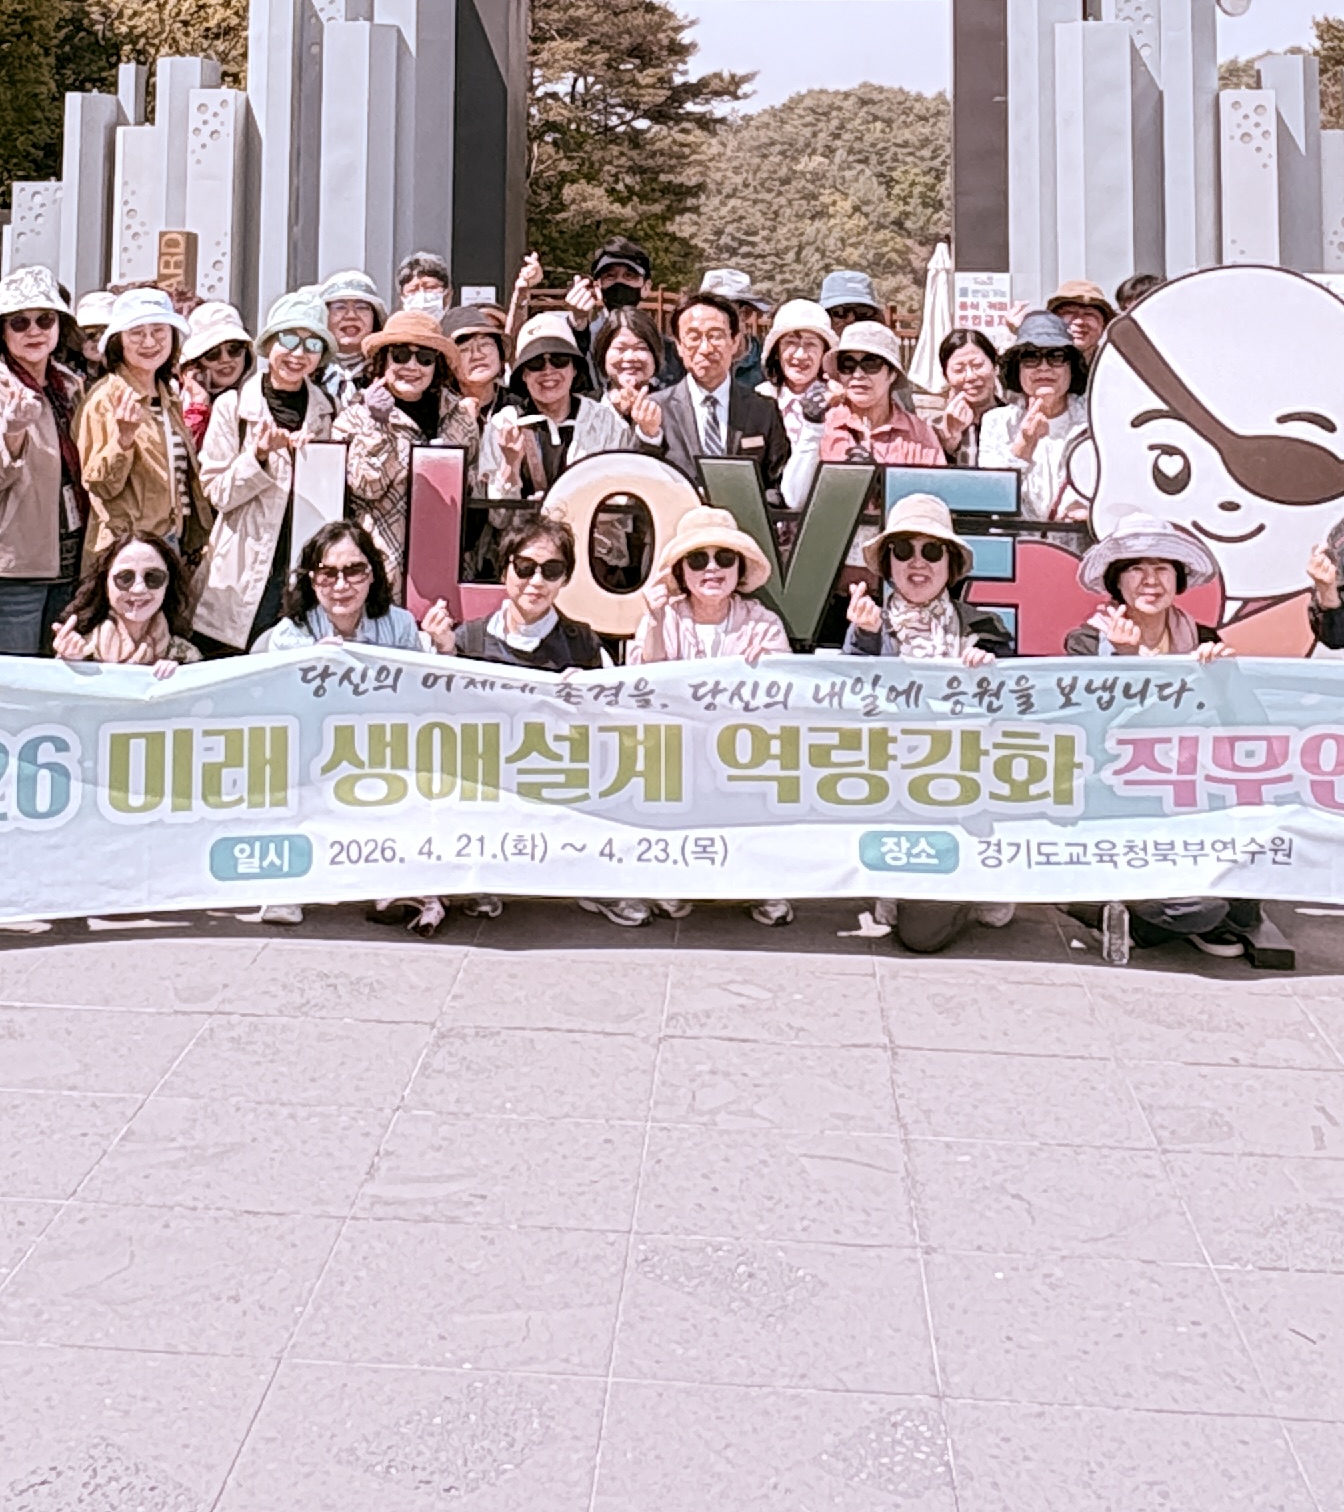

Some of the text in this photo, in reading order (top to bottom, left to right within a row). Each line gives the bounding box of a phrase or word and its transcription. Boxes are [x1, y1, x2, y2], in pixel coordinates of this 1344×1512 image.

[406, 445, 1021, 655] LOVE
[299, 665, 403, 698] 당신의
[689, 676, 792, 712] 당신의
[811, 674, 923, 717] 내일에
[941, 675, 1036, 716] 응원을
[1056, 674, 1207, 716] 보냅니다.
[107, 724, 289, 815] 미래
[321, 721, 684, 808] 생애설계
[716, 723, 1083, 808] 역량강화
[233, 840, 291, 873] 일시
[329, 839, 407, 866] 2026.
[418, 838, 443, 863] 4.
[455, 833, 549, 863] 21.(화)
[598, 838, 625, 865] 4.
[637, 834, 729, 867] 23.(목)
[880, 836, 1295, 870] 장소 경기도교육청북부연수원
